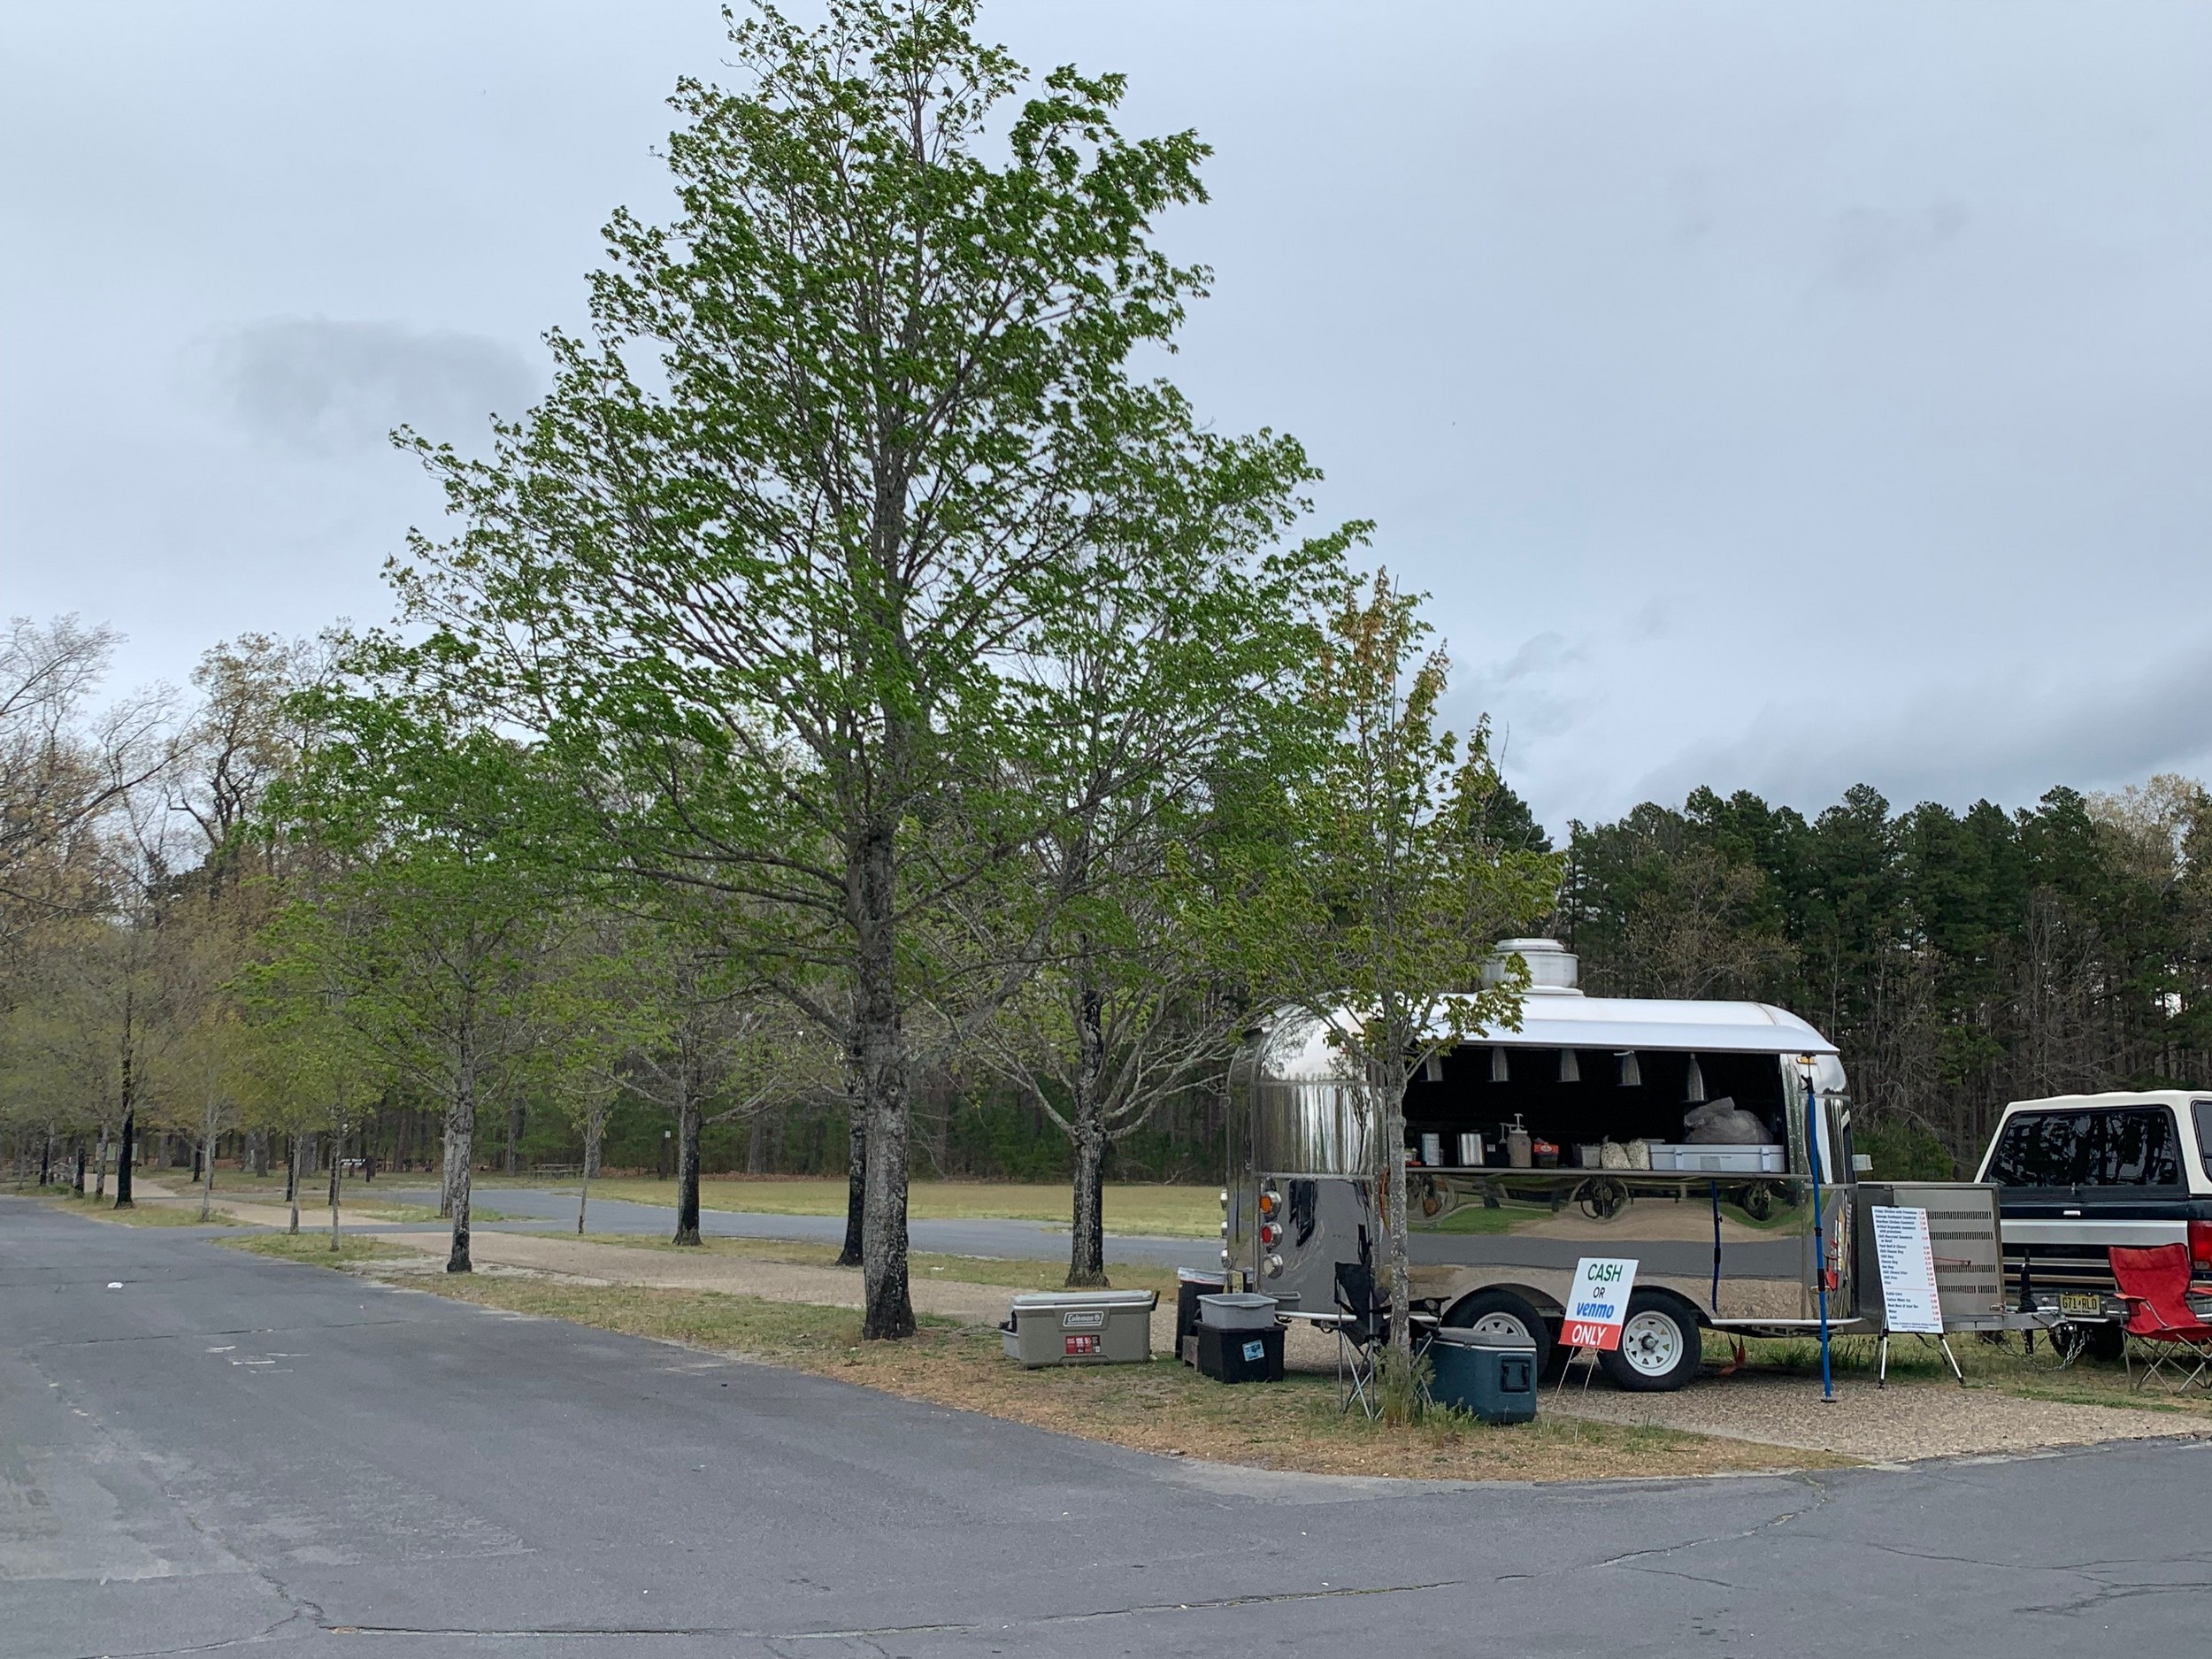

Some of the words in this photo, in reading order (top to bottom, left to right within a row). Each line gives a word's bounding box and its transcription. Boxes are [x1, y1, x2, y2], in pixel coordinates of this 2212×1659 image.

[1587, 1263, 1623, 1282] CASH
[1593, 1286, 1605, 1299] OR
[1577, 1302, 1615, 1319] venmo
[1571, 1324, 1608, 1346] ONLY
